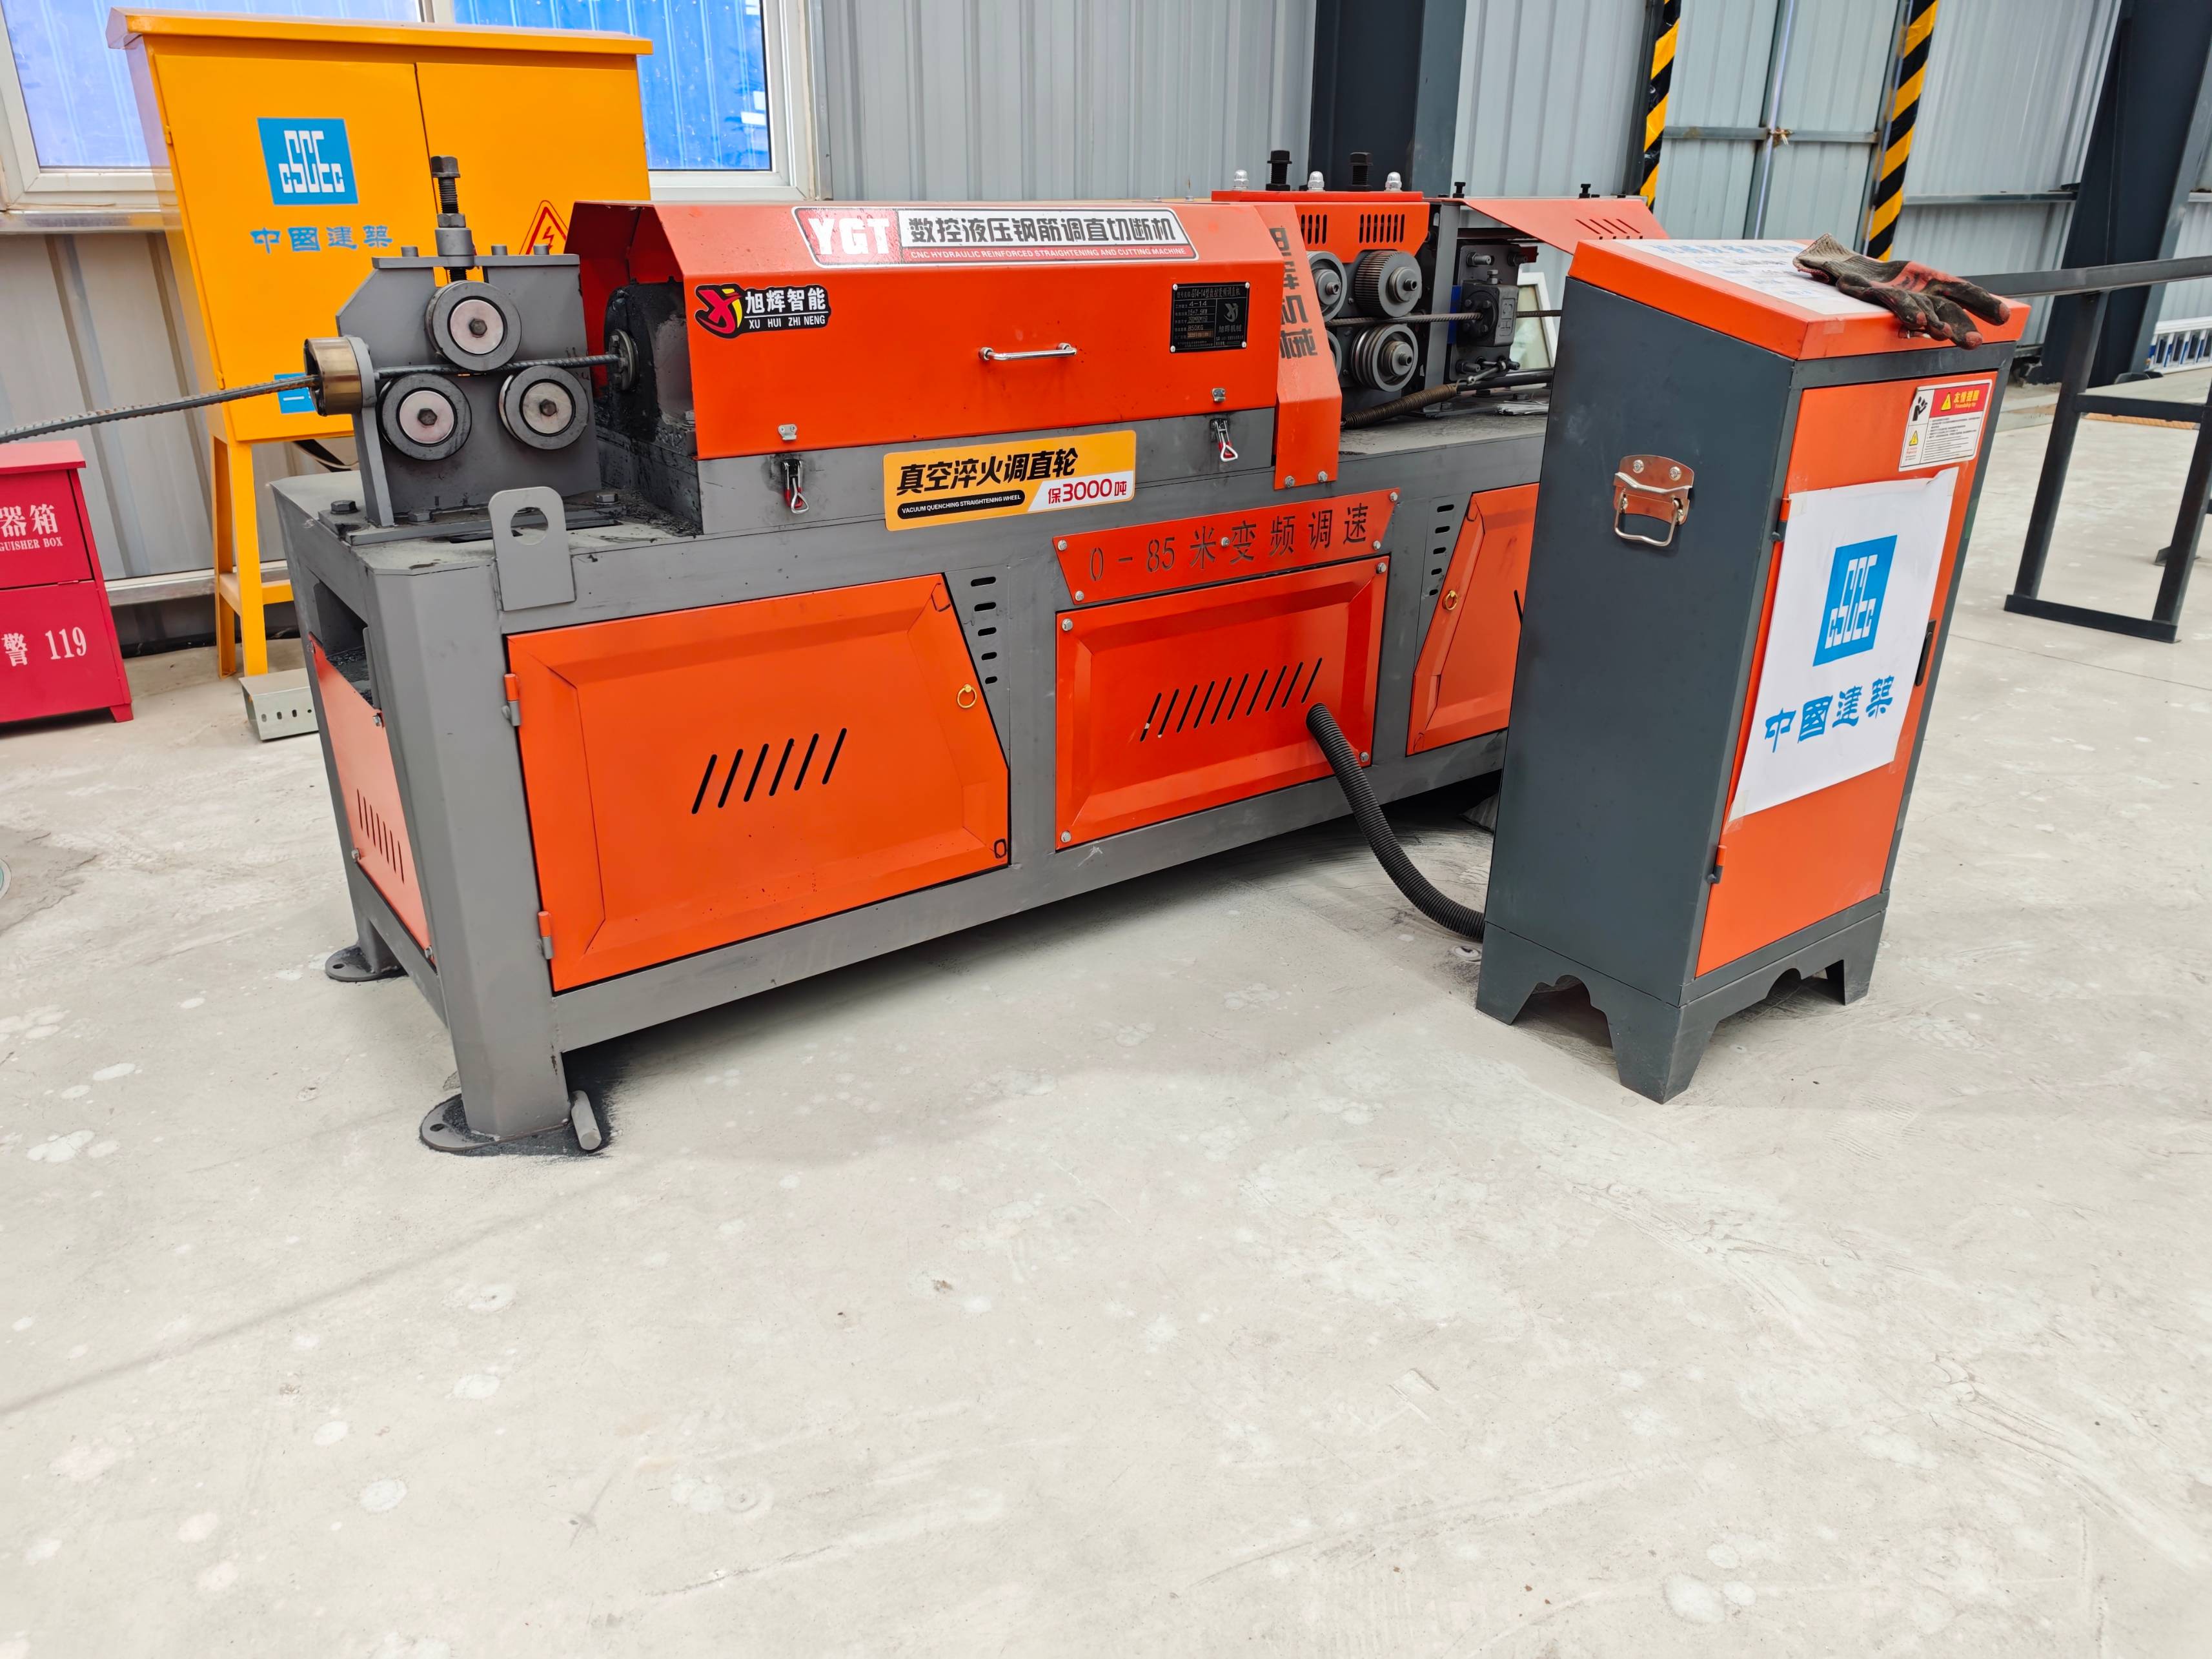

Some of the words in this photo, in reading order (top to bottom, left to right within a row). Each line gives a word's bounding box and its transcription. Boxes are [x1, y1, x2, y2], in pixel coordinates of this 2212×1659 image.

[250, 225, 393, 254] 中國建築
[808, 218, 889, 255] YGT
[908, 218, 1176, 243] 数控液压钢筋调直切断机
[982, 249, 1033, 258] REINFORCED
[1035, 249, 1099, 257] STRAIGHTENING
[745, 287, 826, 314] 旭辉智能
[749, 320, 760, 329] XU
[767, 318, 782, 328] HUI
[788, 317, 800, 327] ZHI
[804, 315, 826, 325] NENG
[897, 447, 1078, 496] 真空淬火调直轮
[902, 505, 926, 514] VACUUM
[927, 501, 959, 511] QUENCHING
[960, 496, 1002, 507] STRAIGHTENING
[1003, 494, 1021, 502] WHEEL
[1048, 478, 1127, 505] 保3000吨
[0, 504, 58, 537] 器箱
[43, 536, 63, 547] BOX
[1, 633, 28, 666] 警
[45, 627, 87, 660] 119
[1765, 675, 1895, 753] 中國建築
